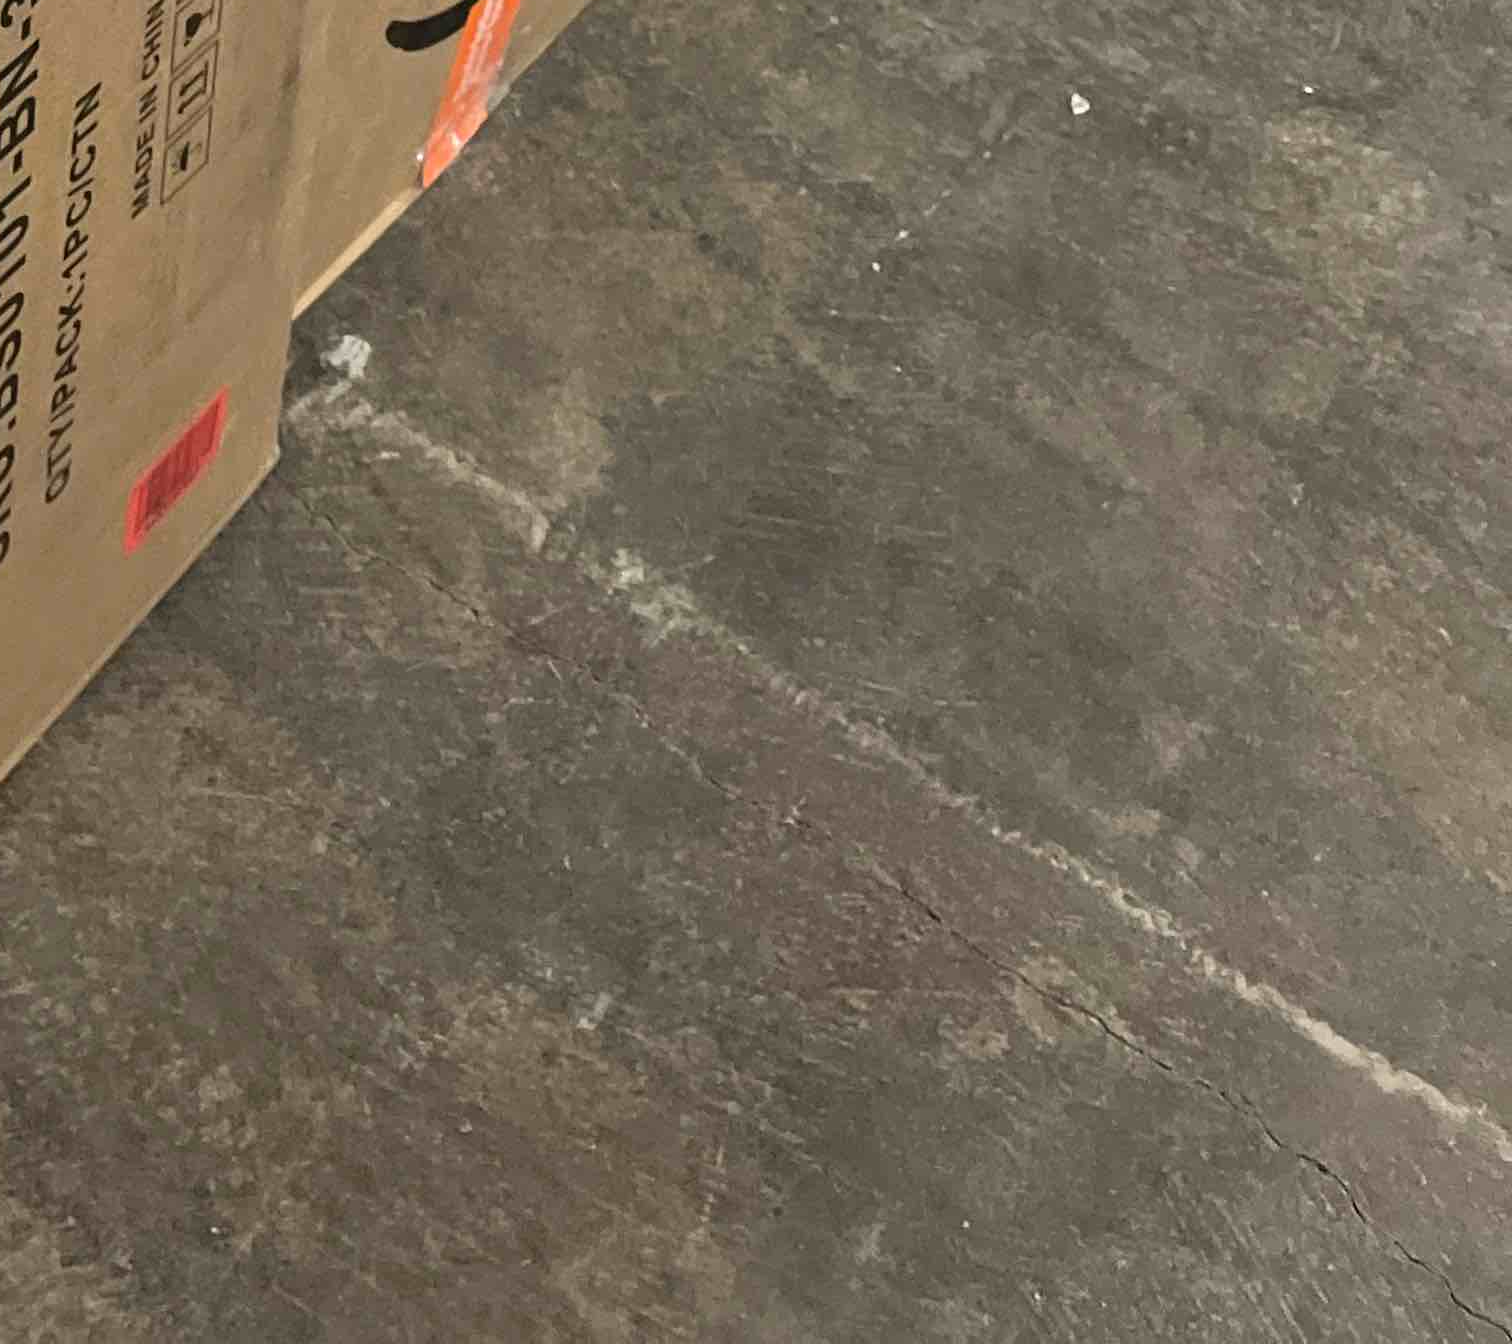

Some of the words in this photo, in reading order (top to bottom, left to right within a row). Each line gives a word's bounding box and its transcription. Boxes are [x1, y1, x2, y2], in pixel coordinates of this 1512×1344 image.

[139, 84, 157, 124] IN
[131, 123, 155, 219] MADE
[45, 82, 101, 504] QTY/PACK:1PC/CTN
